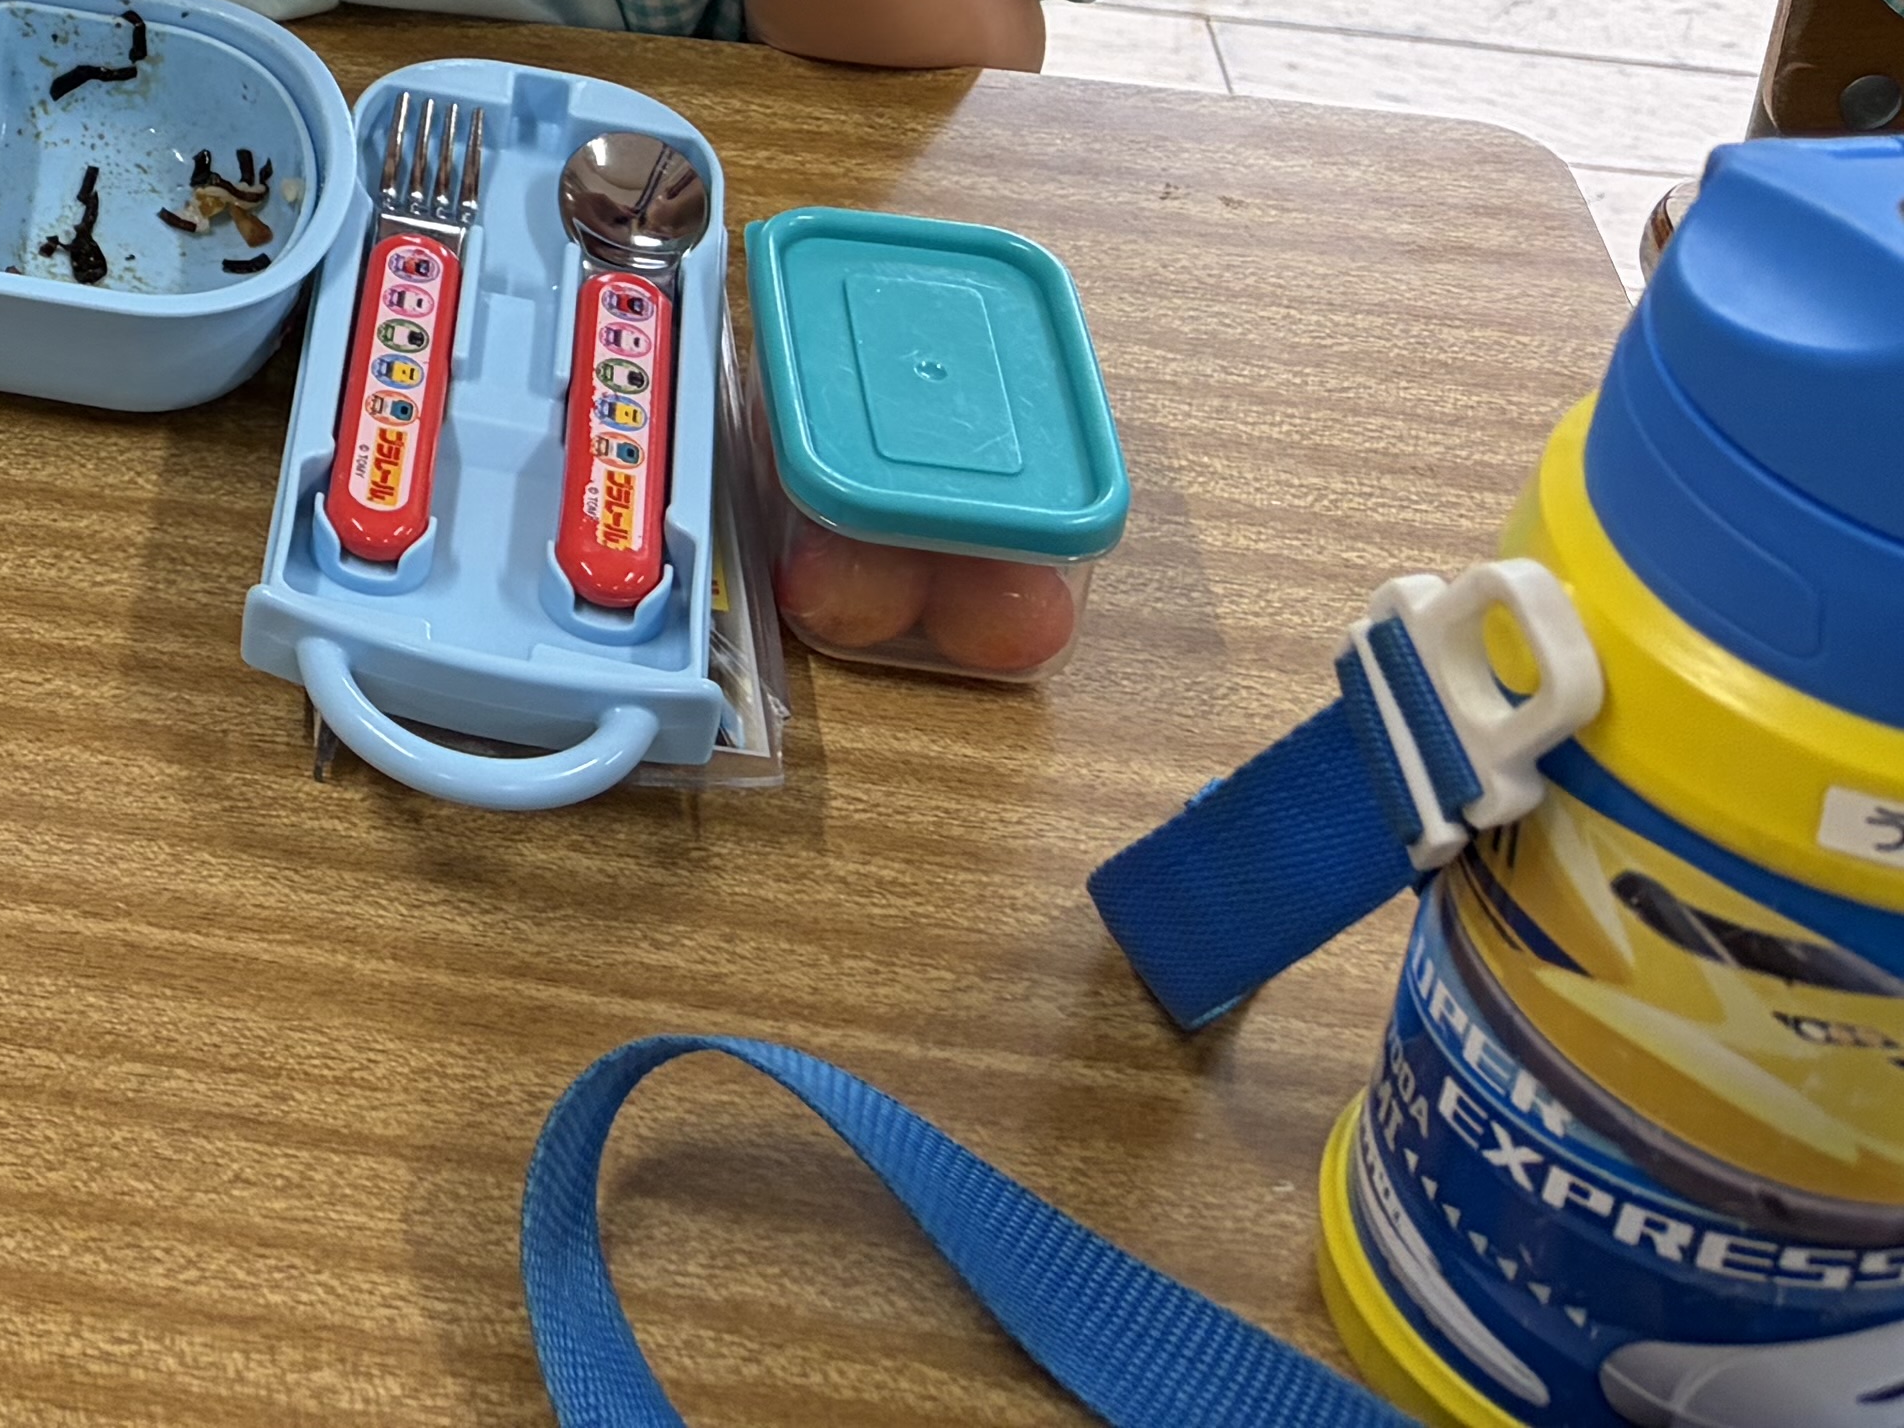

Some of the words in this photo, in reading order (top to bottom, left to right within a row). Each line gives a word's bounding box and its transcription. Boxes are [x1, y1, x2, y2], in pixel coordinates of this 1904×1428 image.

[355, 454, 369, 479] TOMY
[367, 427, 405, 502] プラレール
[601, 469, 634, 546] プラレール
